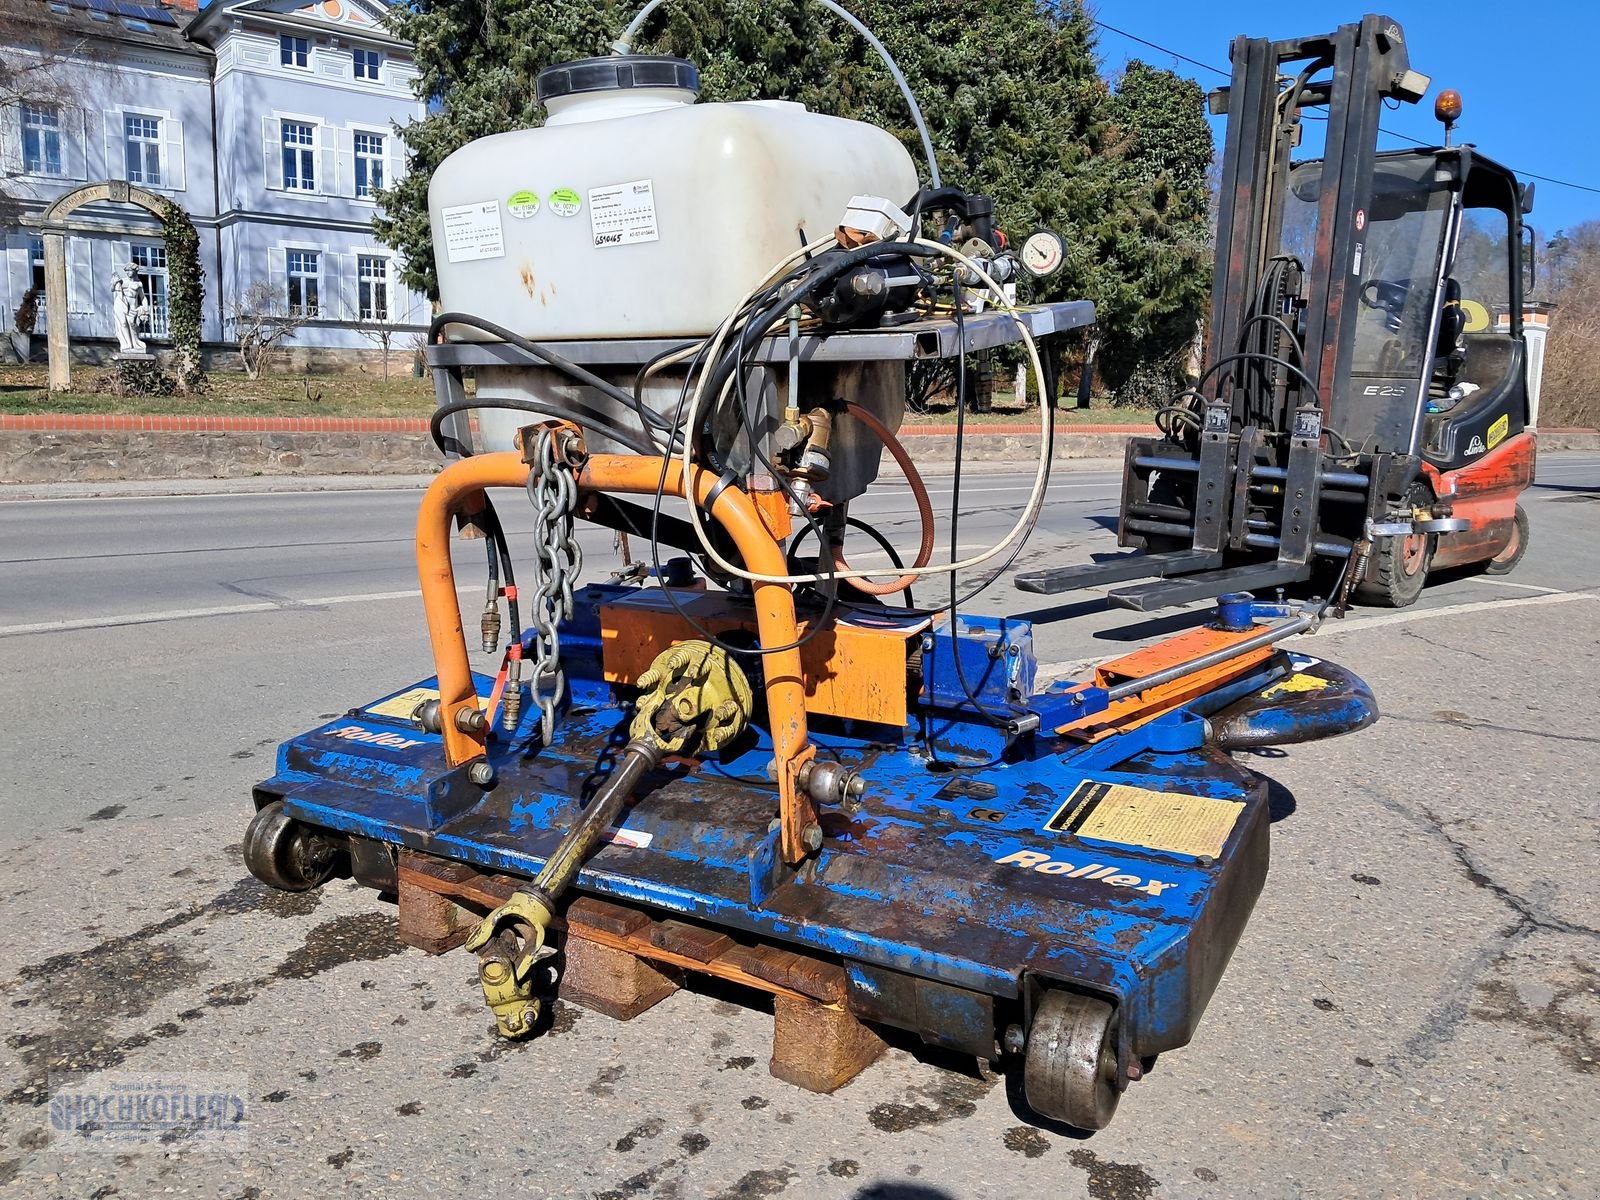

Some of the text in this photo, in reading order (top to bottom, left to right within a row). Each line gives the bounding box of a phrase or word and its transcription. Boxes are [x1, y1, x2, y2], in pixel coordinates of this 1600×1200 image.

[1363, 385, 1407, 397] E25
[1464, 434, 1486, 455] Linde
[323, 725, 425, 749] Rollex
[994, 849, 1179, 897] Rollex
